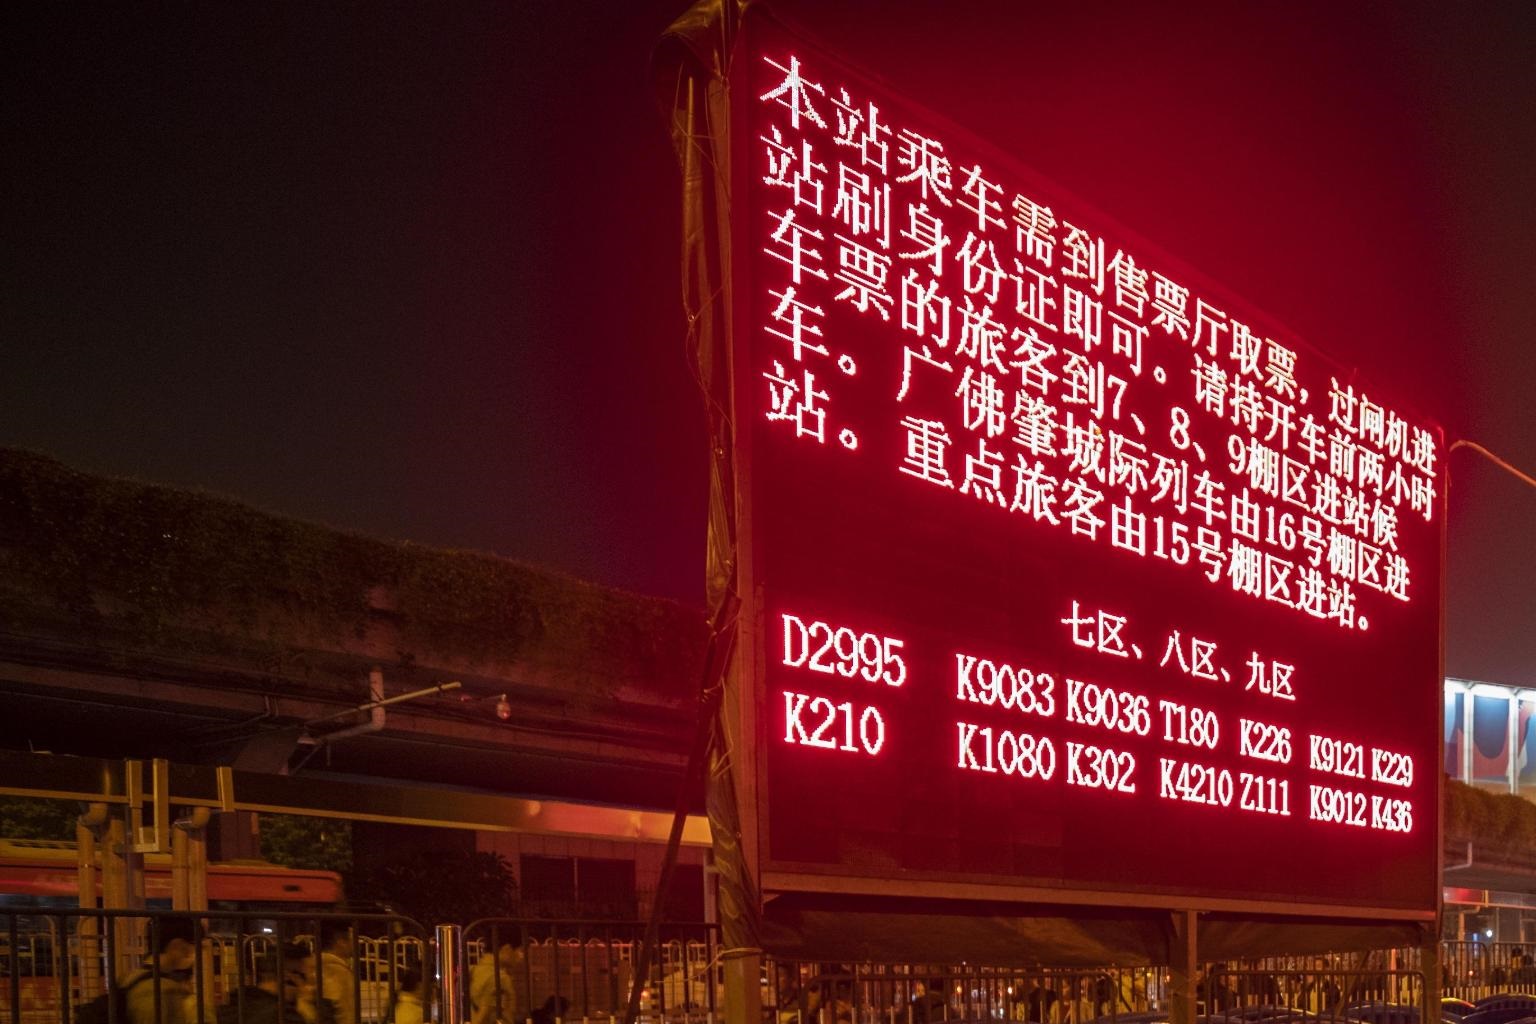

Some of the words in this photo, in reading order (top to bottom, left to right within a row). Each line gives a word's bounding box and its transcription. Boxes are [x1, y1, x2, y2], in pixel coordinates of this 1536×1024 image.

[761, 54, 1438, 478] 本站乘车需到售票厅取票，过闸机进
[761, 125, 1438, 522] 站刷身份证即可。请持开车前两小时
[763, 209, 1398, 551] 车票的旅客到7、8、9棚区进站候
[763, 360, 1370, 630] 站。重点旅客由15号棚区进站。
[764, 286, 1412, 602] 车。广佛肇城际列车由16号棚区进
[782, 614, 906, 687] D2995
[956, 654, 1055, 717] K9083
[1066, 678, 1151, 736] K9036
[1160, 700, 1220, 749] T180
[1240, 718, 1292, 764] K226
[1310, 734, 1366, 779] K9121
[1372, 747, 1414, 788] K229
[783, 692, 885, 756] K210
[957, 721, 1056, 780] K1080
[1067, 742, 1136, 793] K302
[1160, 757, 1234, 807] K4210
[1240, 773, 1291, 816] Z111
[1310, 785, 1367, 827] K9012
[1372, 795, 1413, 833] K436
[1061, 600, 1296, 701] 七区、八区、九区
